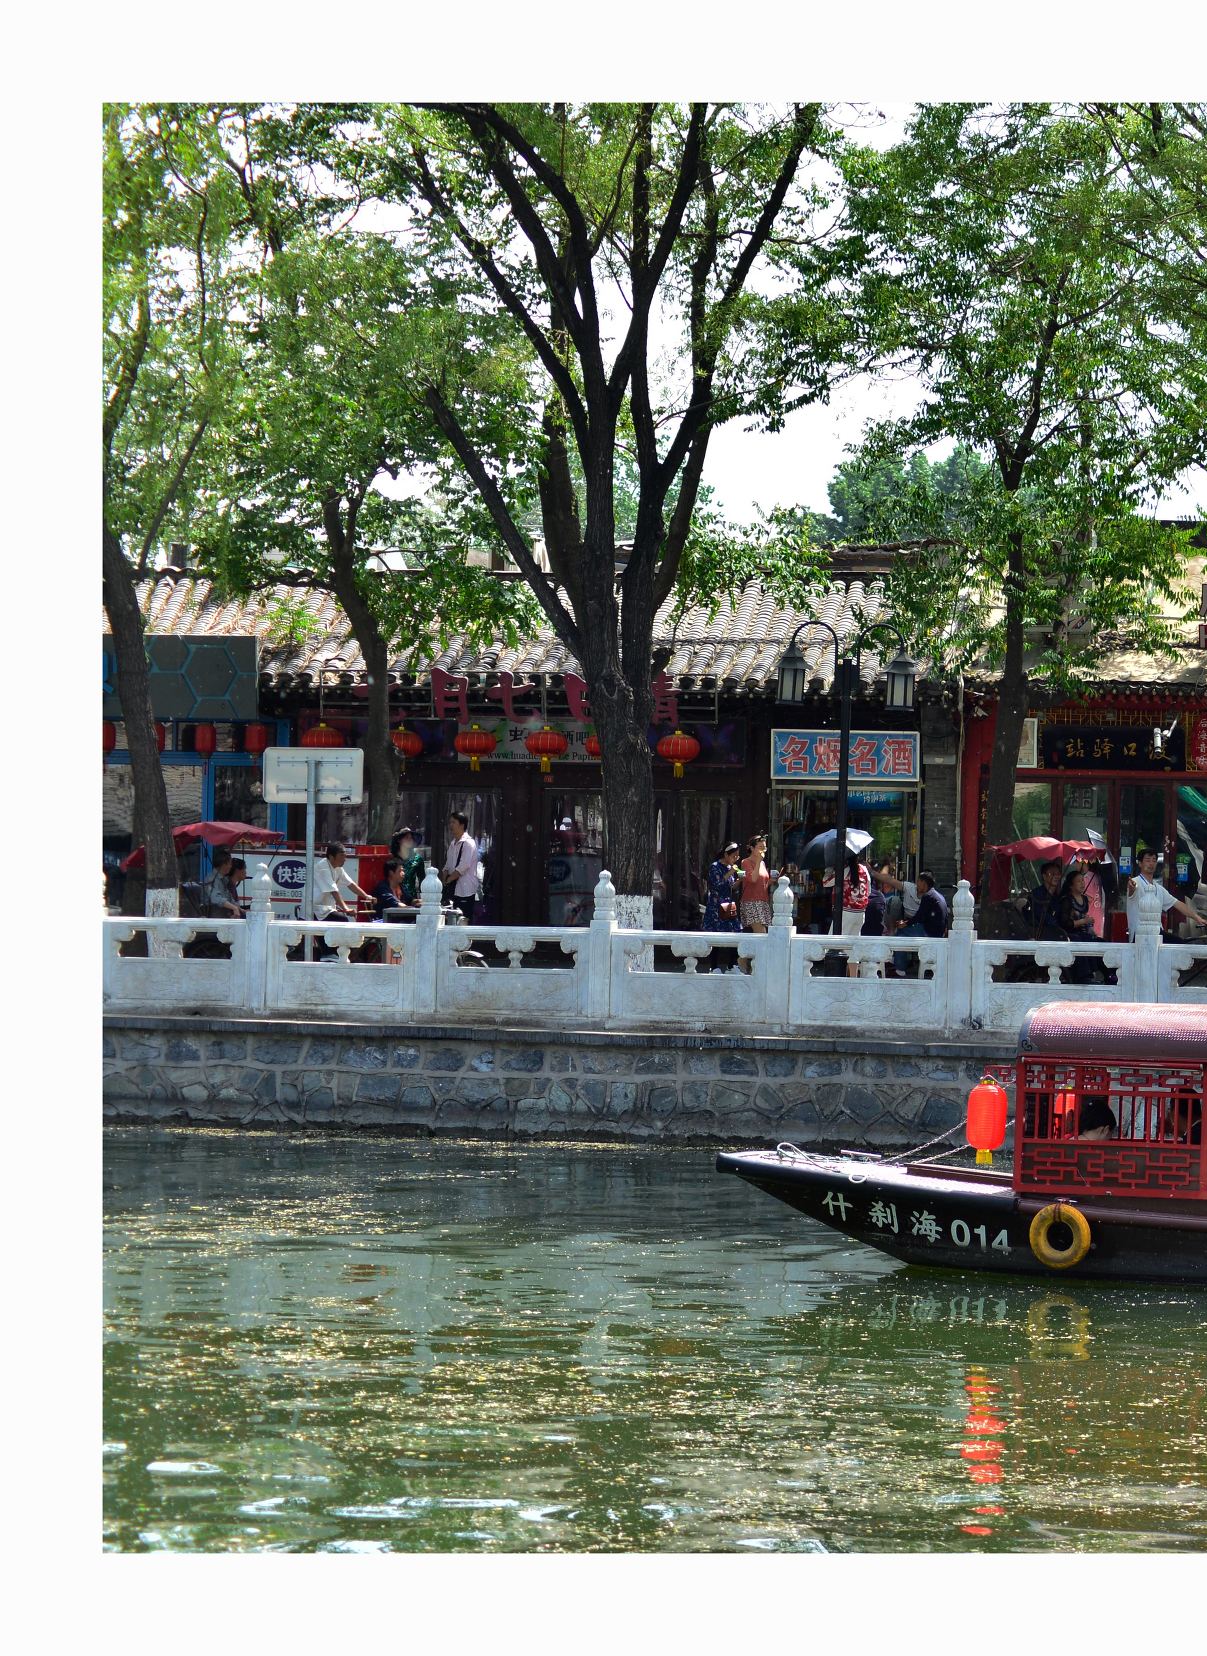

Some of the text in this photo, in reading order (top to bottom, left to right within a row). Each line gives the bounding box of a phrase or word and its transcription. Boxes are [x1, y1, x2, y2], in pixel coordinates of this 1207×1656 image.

[779, 735, 914, 776] 名烟名酒
[822, 1191, 1012, 1255] 什刹海 014
